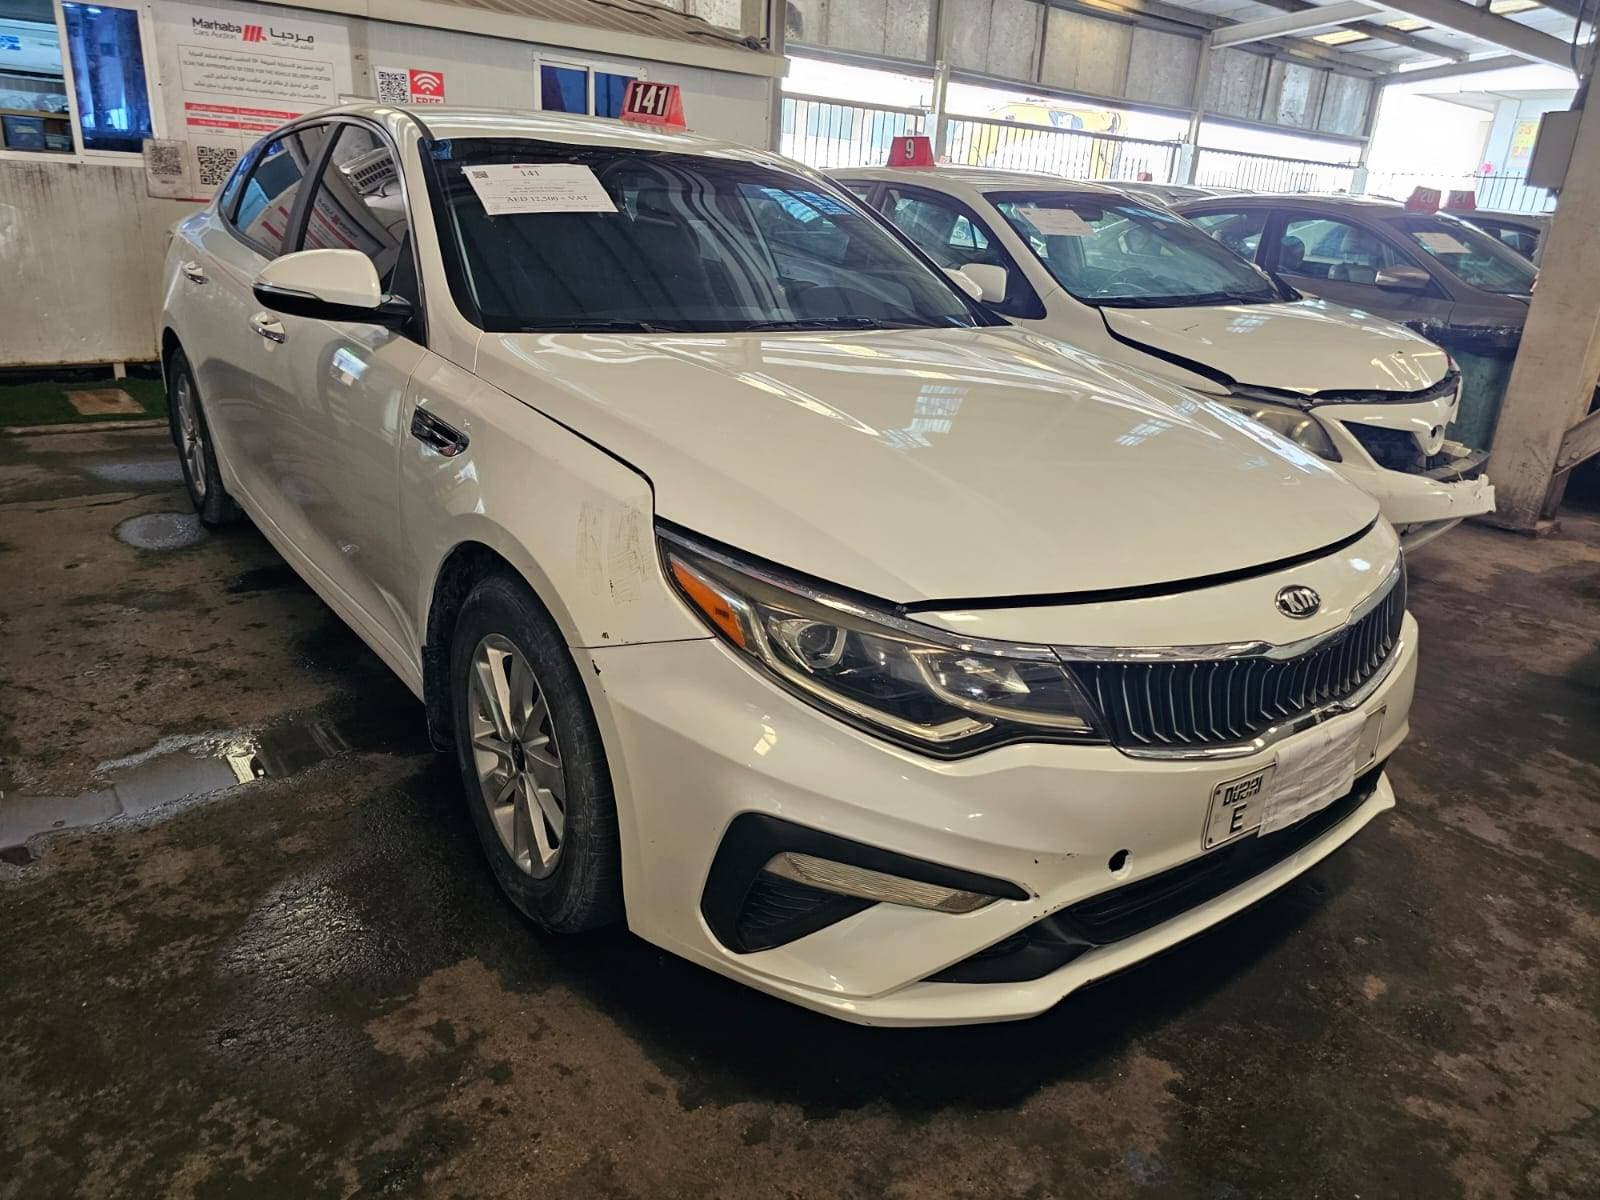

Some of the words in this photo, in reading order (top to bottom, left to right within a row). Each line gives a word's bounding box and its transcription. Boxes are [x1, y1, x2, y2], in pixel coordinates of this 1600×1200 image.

[192, 17, 242, 33] Marhaba
[193, 28, 209, 36] Cars
[211, 31, 237, 40] Auction
[270, 27, 314, 43] مرحبا
[633, 84, 667, 116] 141
[905, 138, 915, 159] 9
[520, 169, 540, 177] 141
[1279, 587, 1319, 613] KIA
[1229, 803, 1248, 834] E
